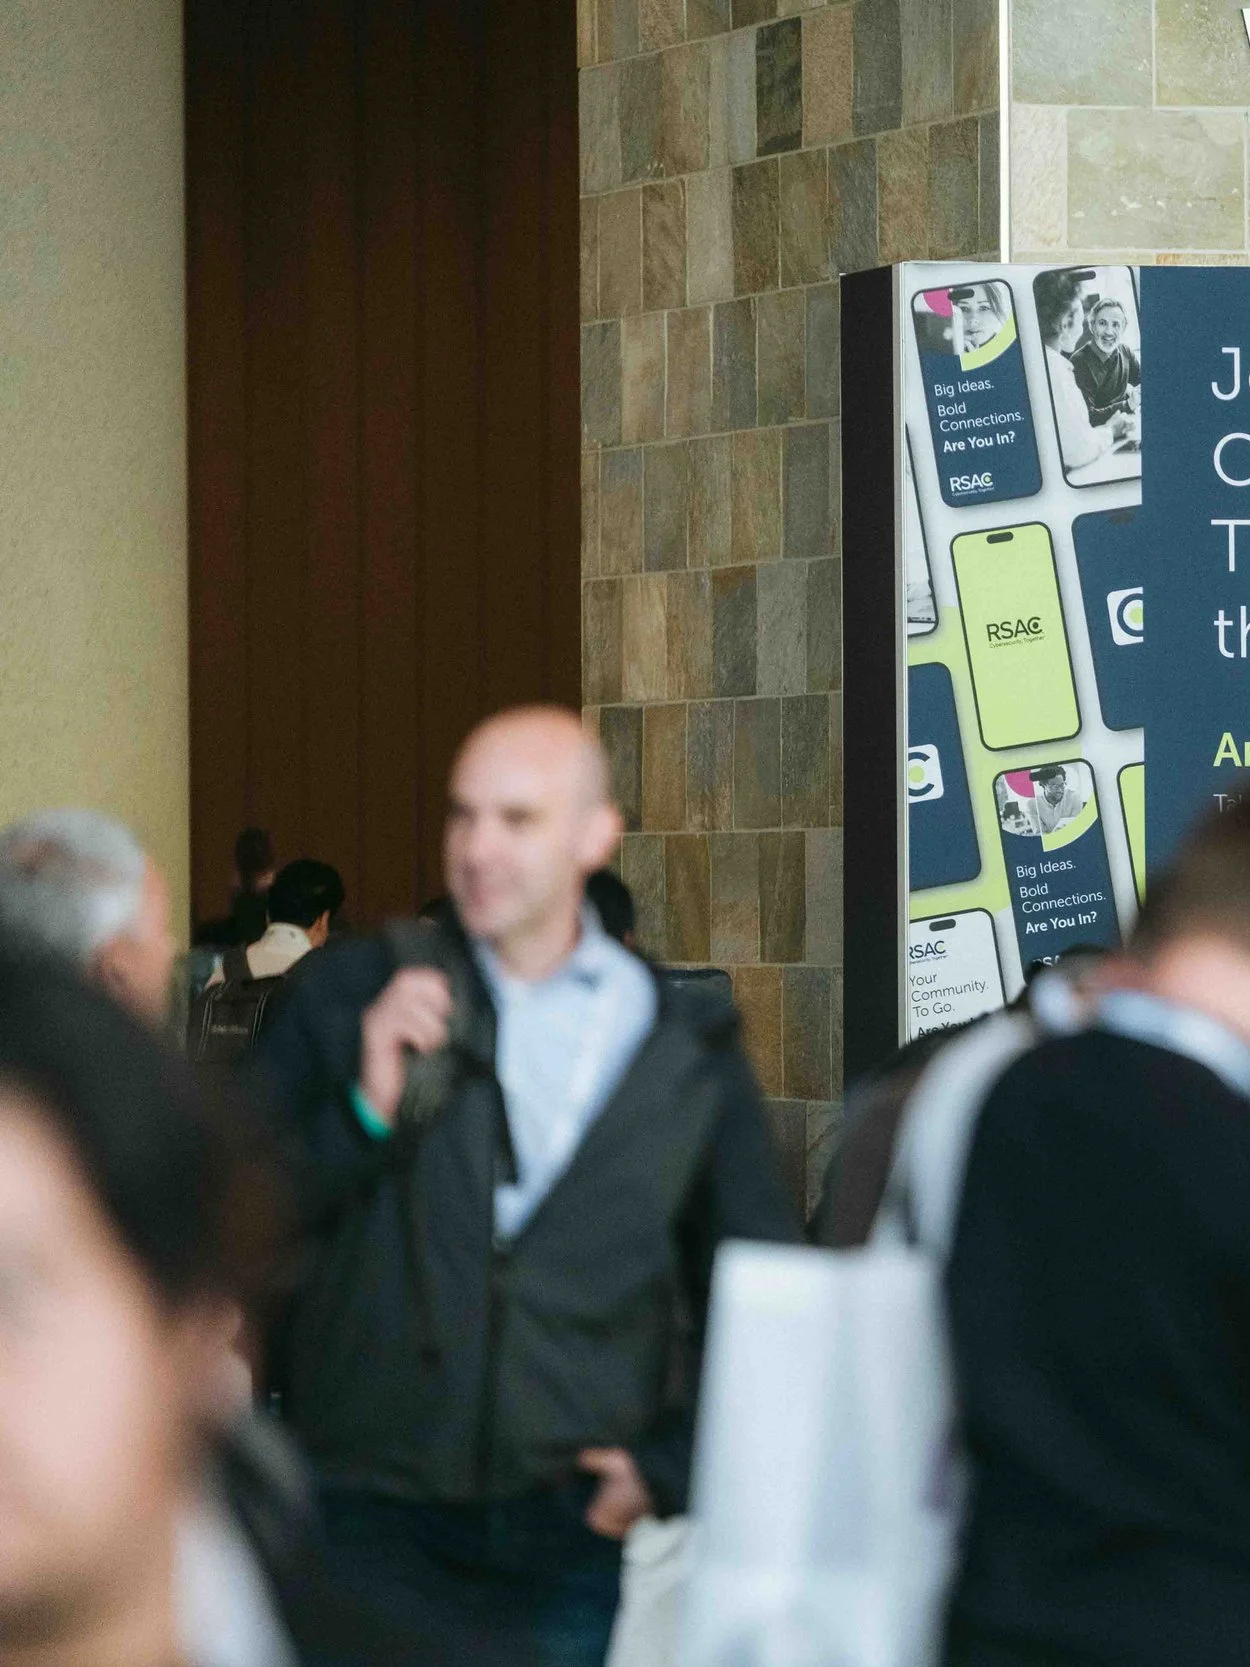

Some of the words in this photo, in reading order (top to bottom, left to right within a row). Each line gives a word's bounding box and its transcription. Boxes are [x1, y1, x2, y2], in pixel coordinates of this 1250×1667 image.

[934, 384, 955, 398] Big
[958, 379, 995, 393] Ideas.
[937, 402, 967, 417] Bold
[939, 411, 1025, 432] Connections.
[943, 440, 966, 453] Are
[967, 436, 994, 449] You
[996, 430, 1016, 445] In?
[949, 472, 994, 492] RSAC
[986, 616, 1043, 642] RSAC
[1016, 865, 1036, 879] Big
[1040, 860, 1076, 874] Ideas.
[1020, 883, 1049, 898] Bold
[1022, 892, 1107, 914] Connections.
[1025, 922, 1048, 935] Are
[1050, 918, 1076, 930] You
[1078, 911, 1098, 925] In?
[909, 973, 938, 987] Your
[911, 980, 989, 1003] Community.
[913, 1005, 929, 1018] To
[932, 1001, 956, 1013] Go.
